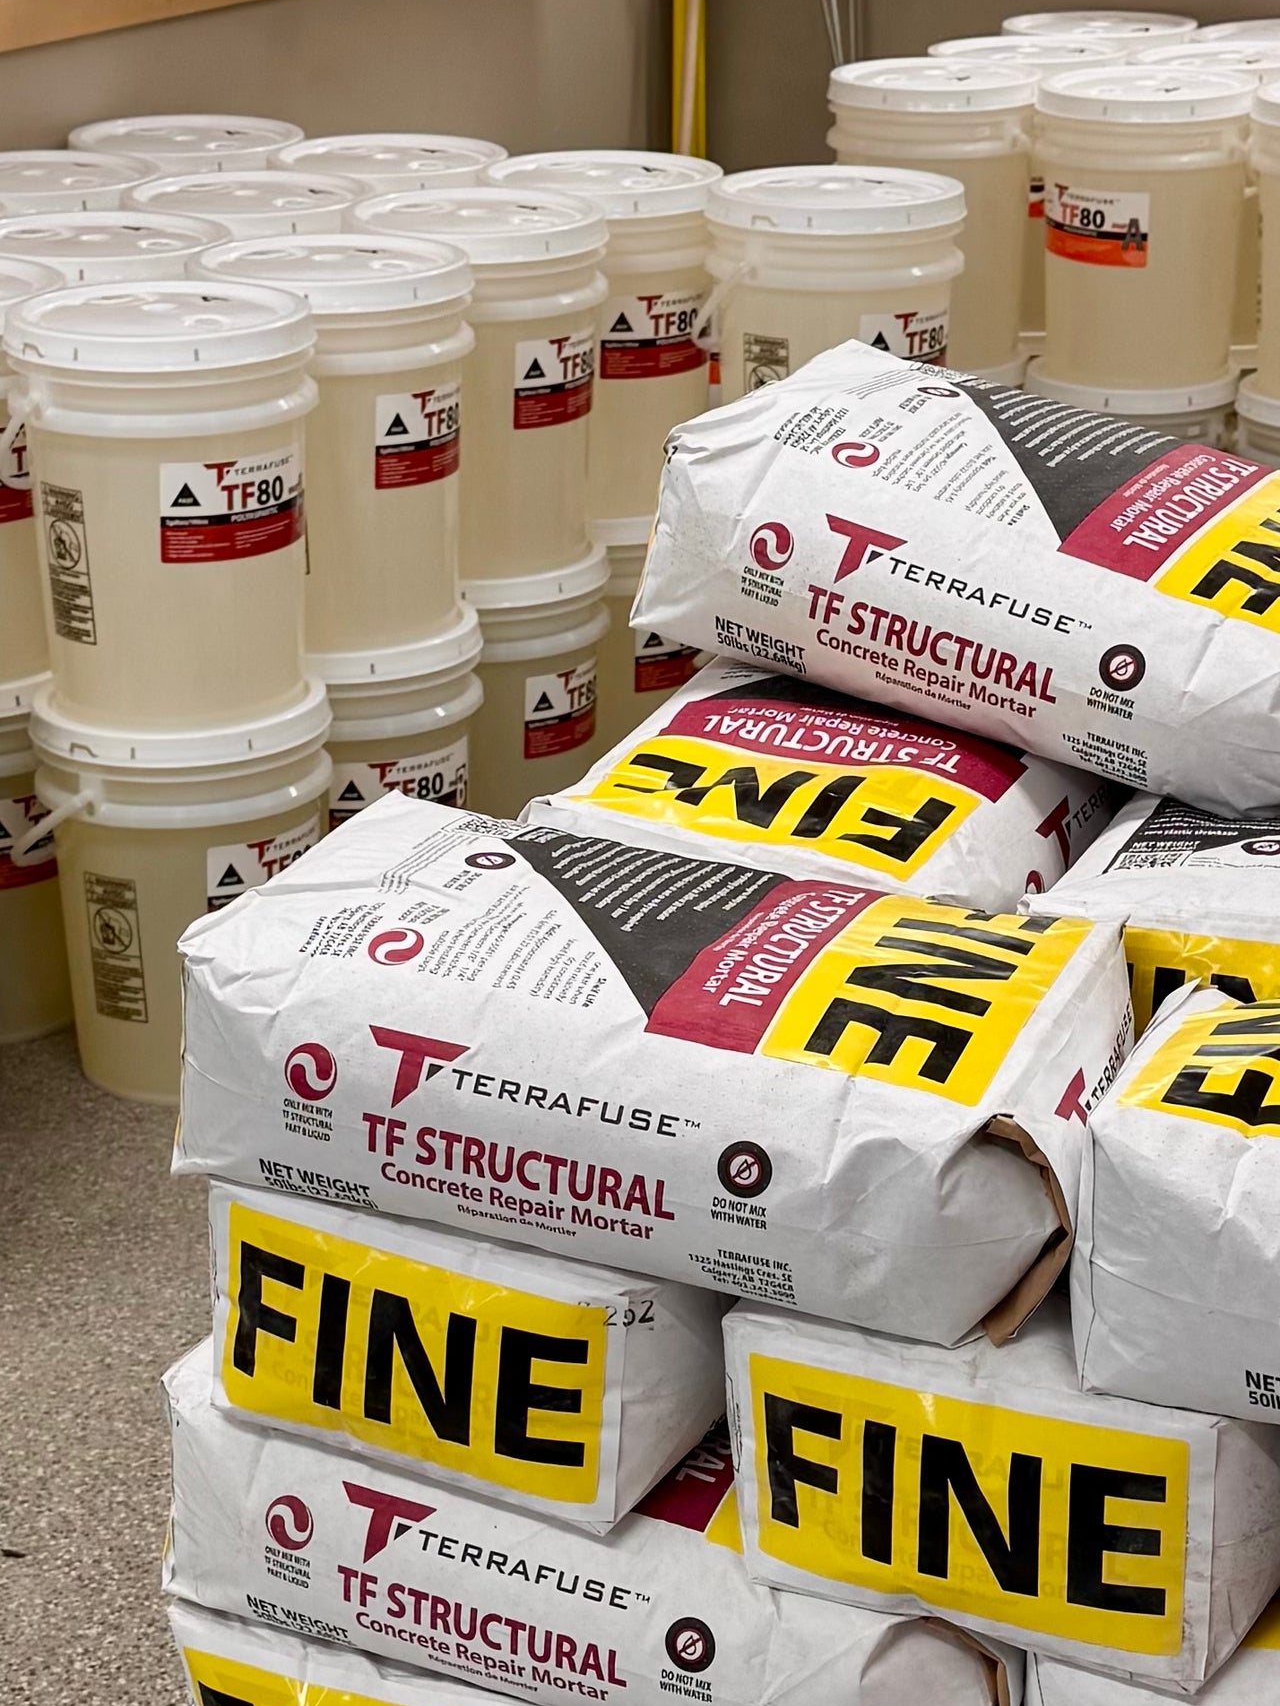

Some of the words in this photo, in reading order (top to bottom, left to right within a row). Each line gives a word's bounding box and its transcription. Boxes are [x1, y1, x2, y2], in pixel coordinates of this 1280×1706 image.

[1060, 203, 1106, 229] TF80
[221, 475, 283, 512] TF80
[806, 584, 845, 620] TF
[849, 601, 1058, 705] STRUCTURAL
[888, 555, 1073, 635] TERRAFUSE
[232, 1240, 592, 1468] FINE
[762, 1390, 1168, 1619] FINE
